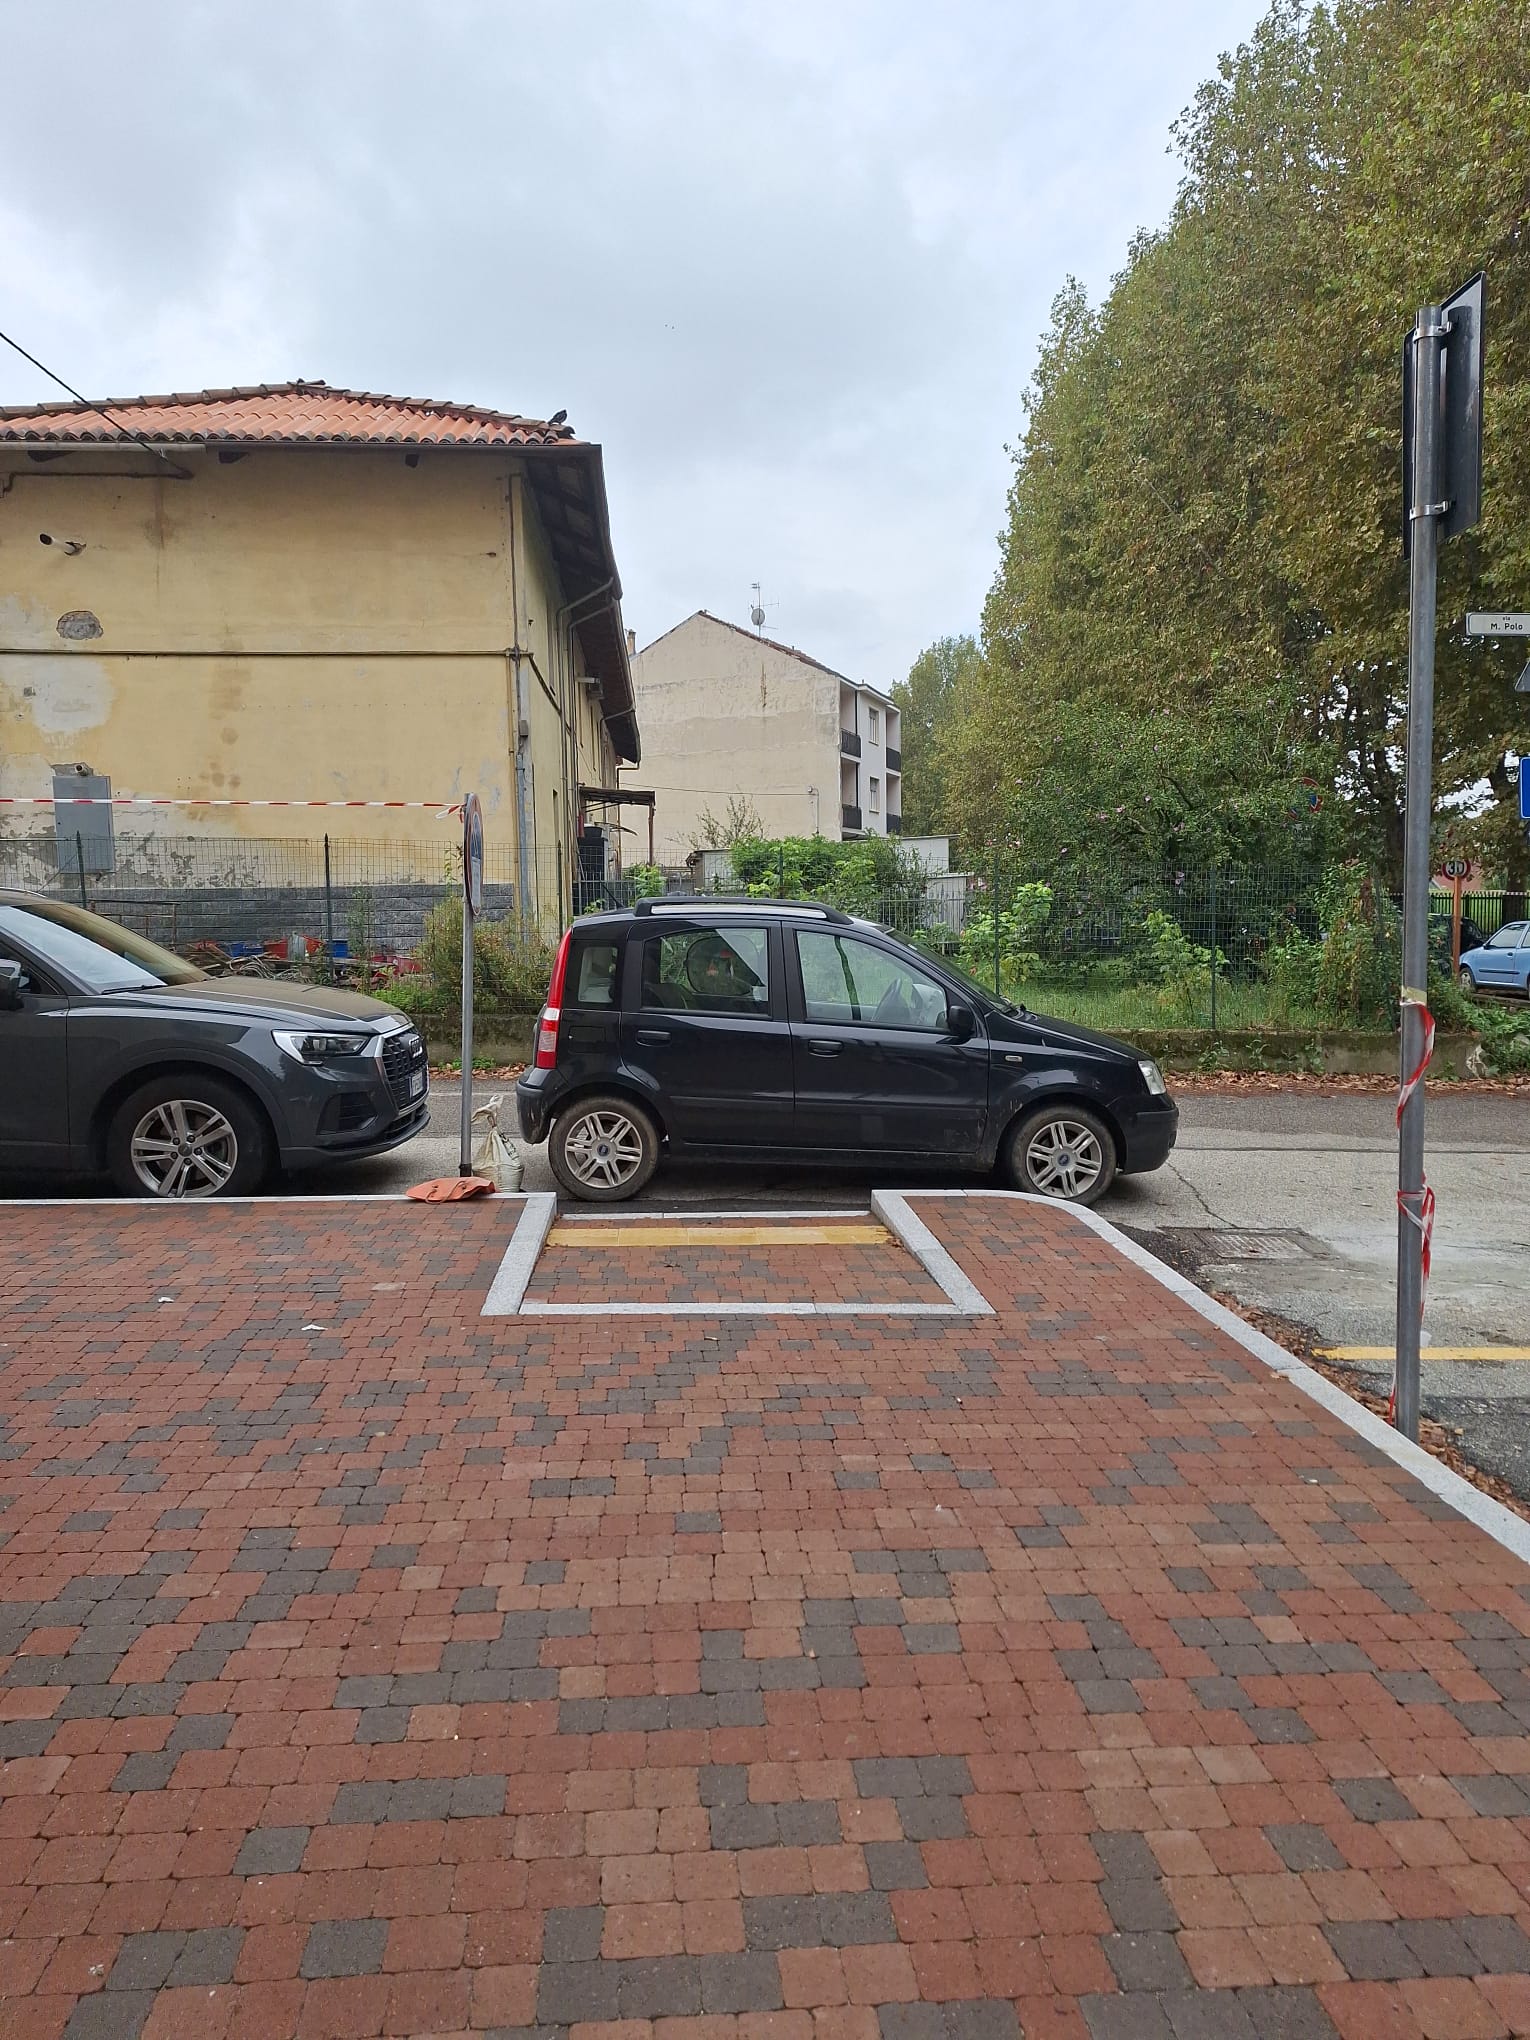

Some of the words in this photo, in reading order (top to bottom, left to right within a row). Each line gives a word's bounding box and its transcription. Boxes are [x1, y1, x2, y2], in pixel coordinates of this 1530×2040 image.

[1490, 622, 1501, 630] M.
[1504, 622, 1523, 630] Polo
[1448, 861, 1465, 875] 30
